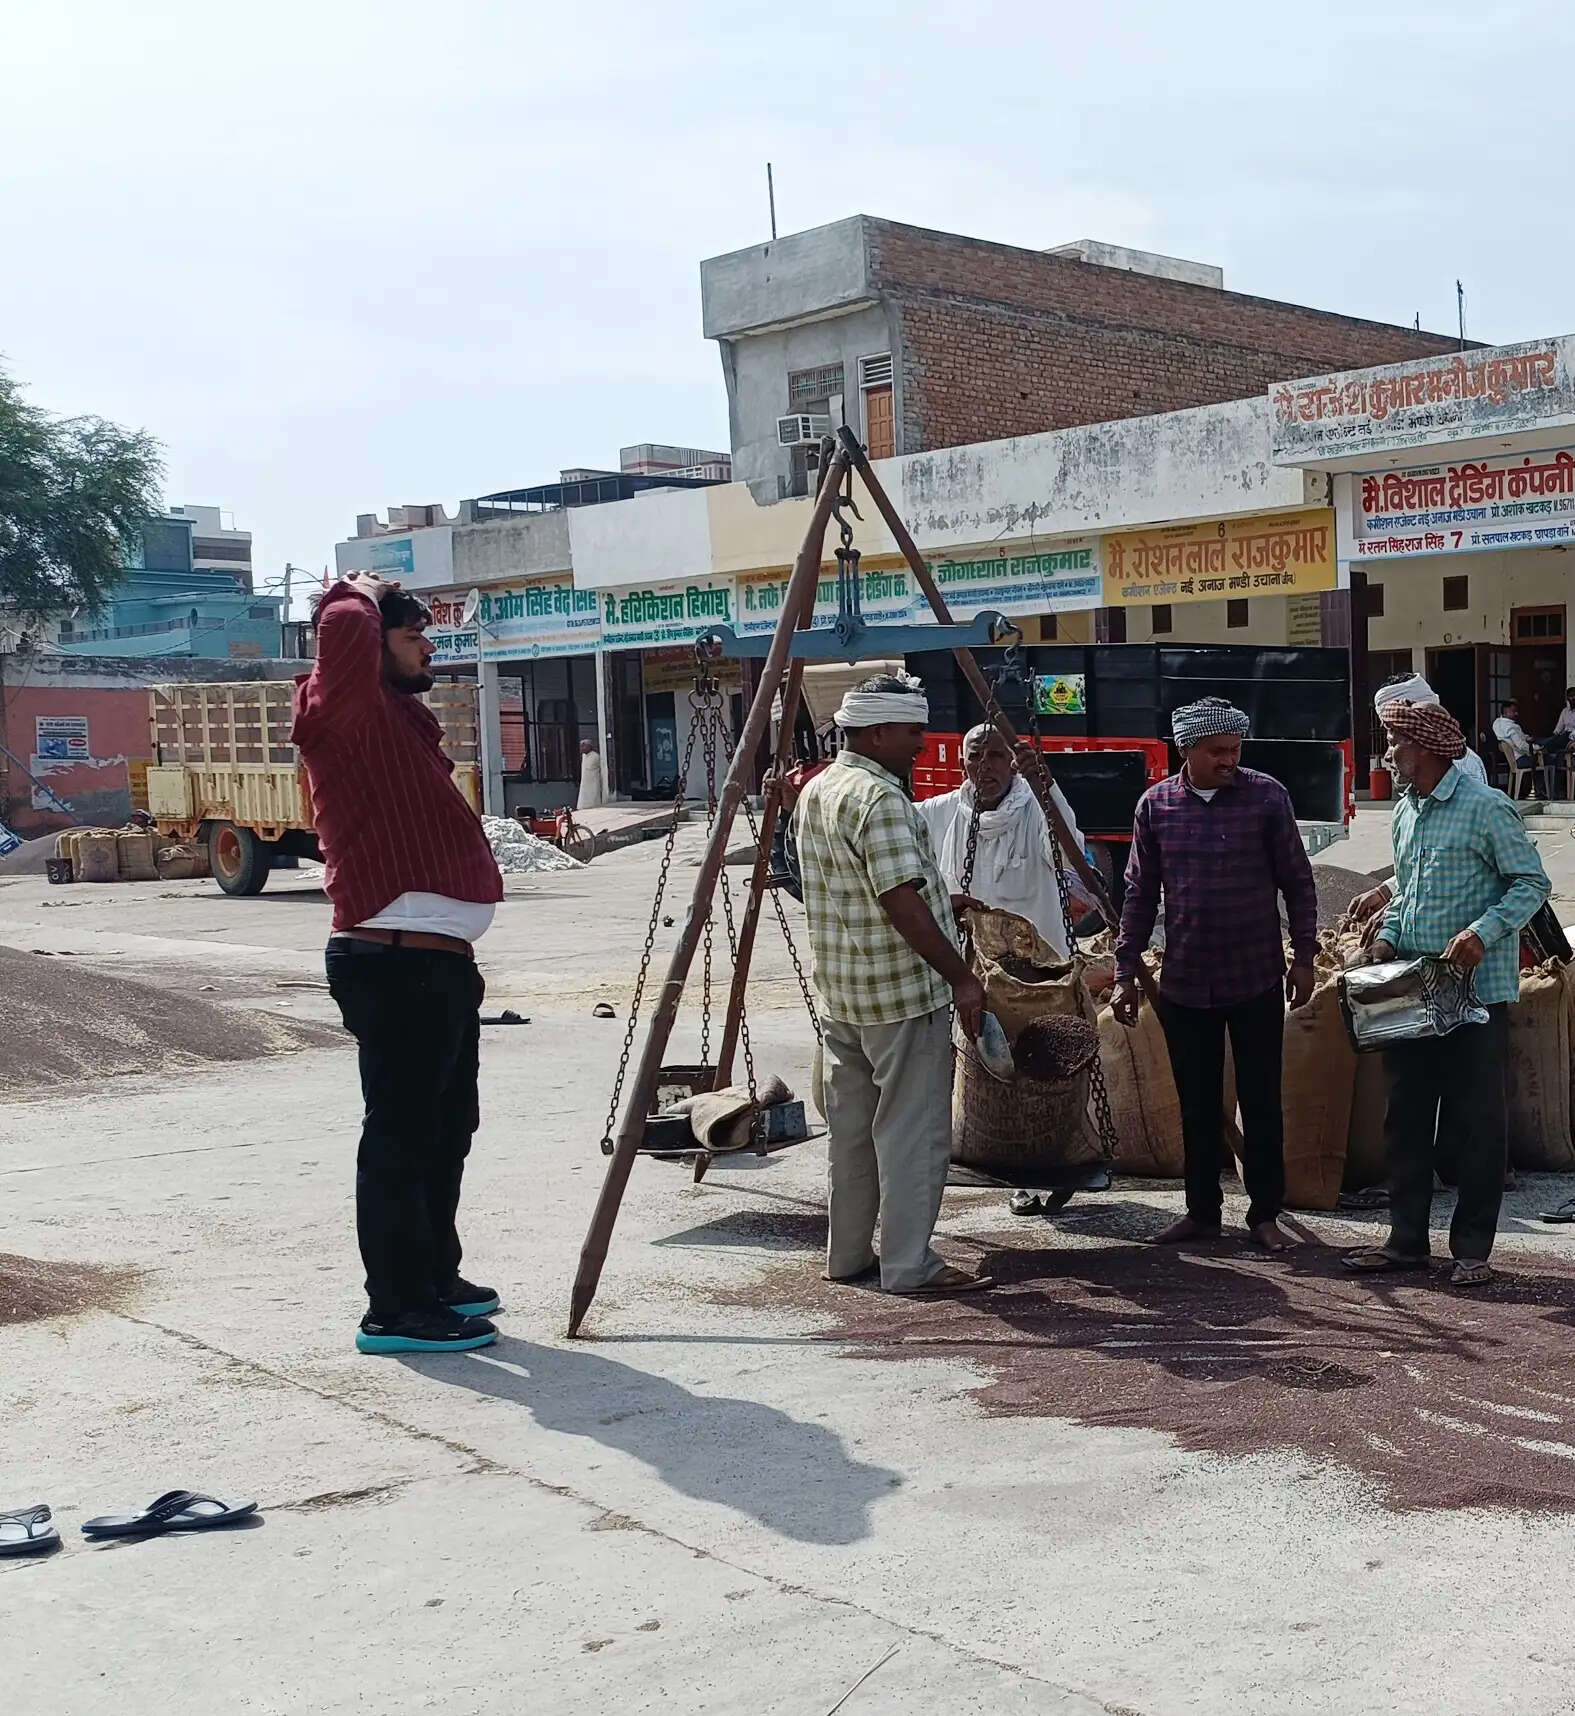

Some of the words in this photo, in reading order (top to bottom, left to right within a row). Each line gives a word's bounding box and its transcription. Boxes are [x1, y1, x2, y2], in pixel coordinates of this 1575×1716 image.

[1447, 462, 1506, 509] ट्रेडिंग
[1217, 521, 1226, 538] 6
[1424, 532, 1445, 551] सिंह
[1450, 530, 1463, 549] 7
[1198, 578, 1226, 592] अनाज
[1228, 571, 1251, 590] मण्डी
[1253, 573, 1281, 588] उचाना
